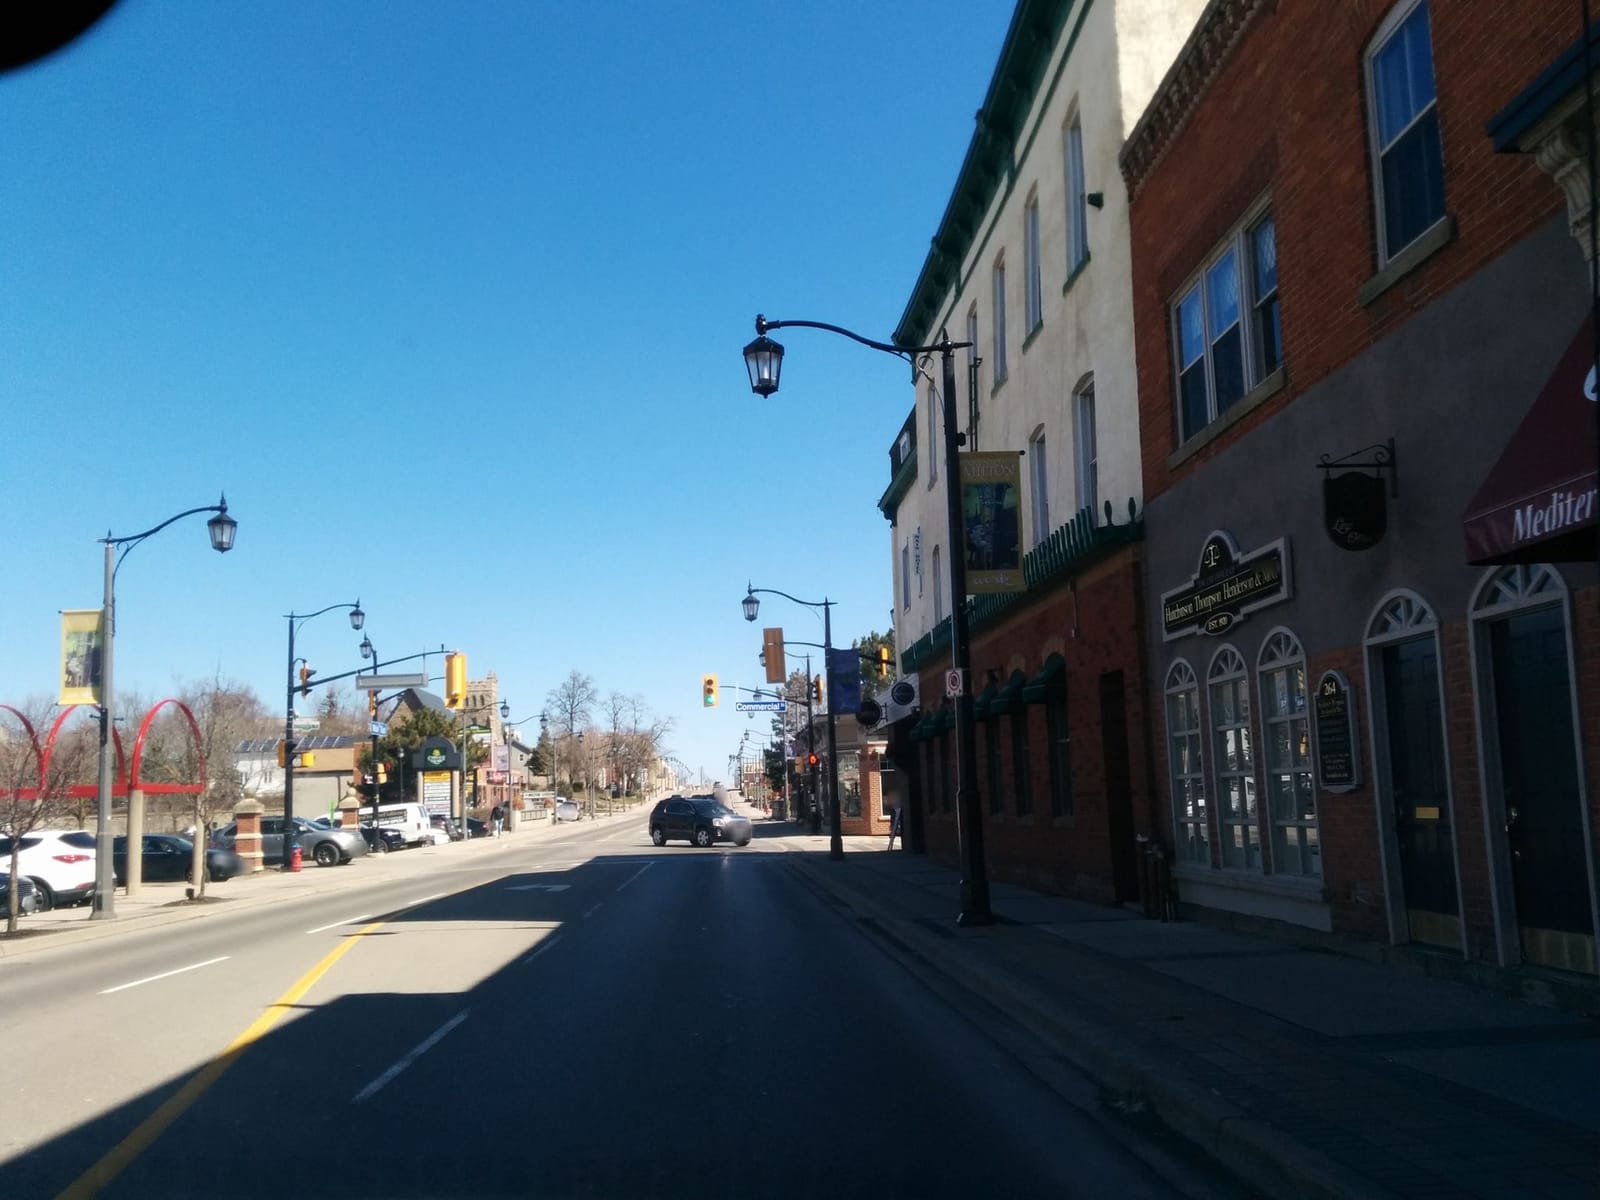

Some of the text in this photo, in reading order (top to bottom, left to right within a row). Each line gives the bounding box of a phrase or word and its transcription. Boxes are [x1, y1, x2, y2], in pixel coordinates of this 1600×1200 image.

[1512, 489, 1598, 544] Mediter
[1165, 602, 1194, 623] Hutchinson
[1194, 591, 1222, 612] Thompson
[1223, 577, 1254, 600] Henderson
[736, 702, 780, 711] Commercial
